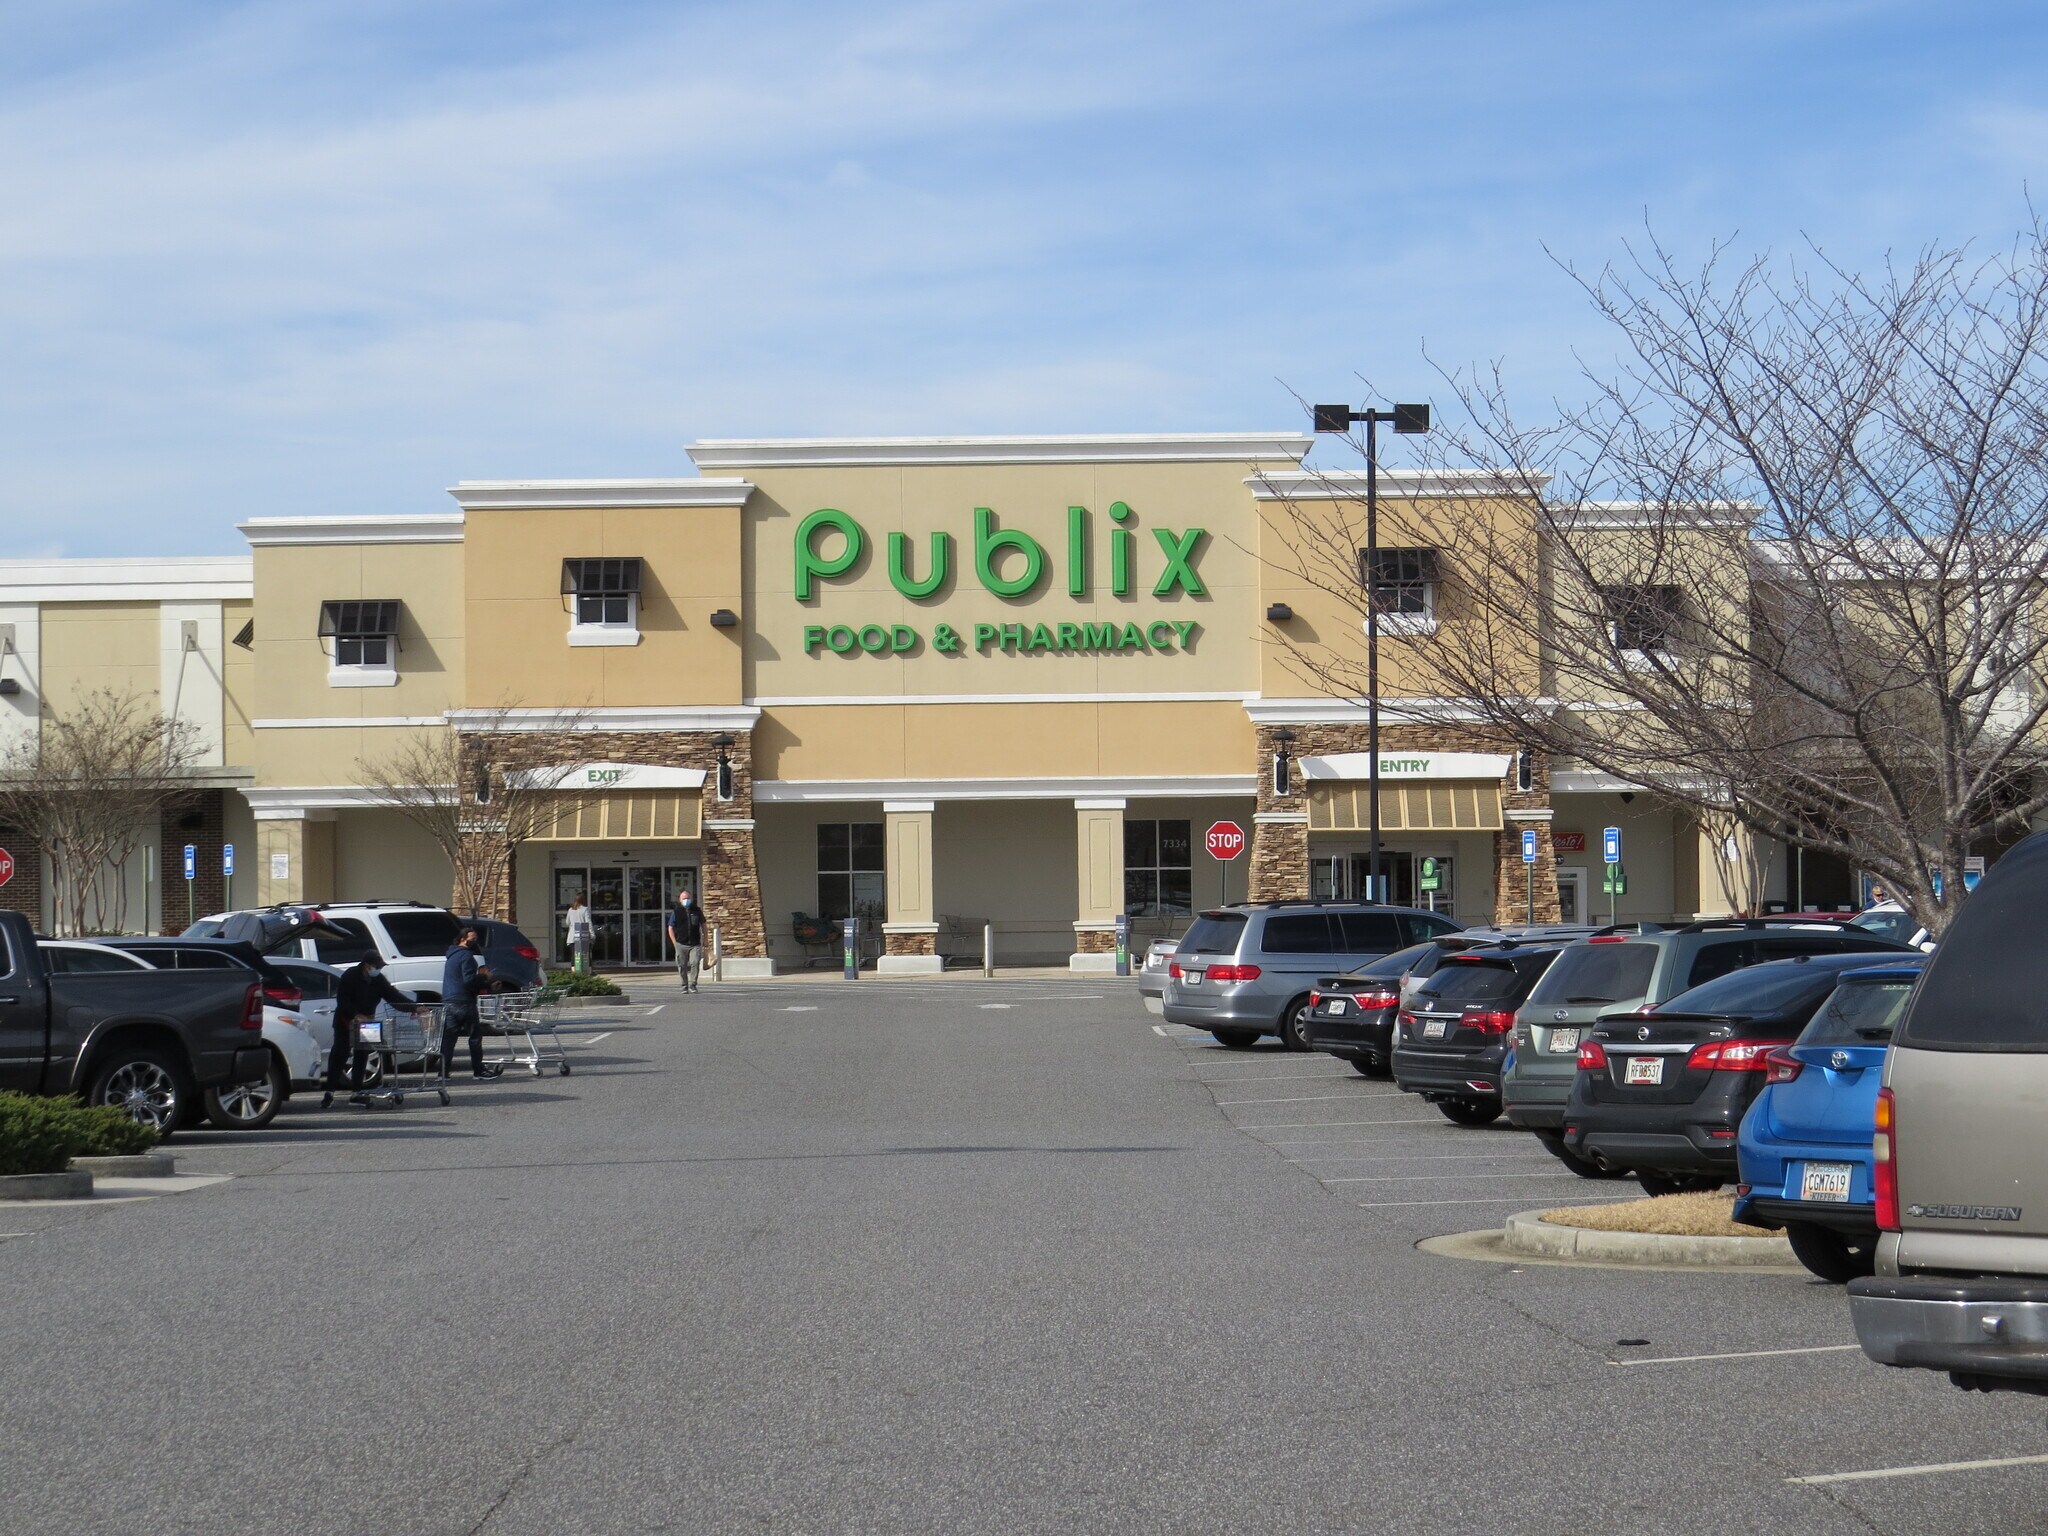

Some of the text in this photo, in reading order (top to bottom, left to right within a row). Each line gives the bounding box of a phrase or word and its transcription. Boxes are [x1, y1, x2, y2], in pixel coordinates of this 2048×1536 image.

[794, 501, 1206, 600] Publix
[804, 621, 1207, 652] FOOD & PHARMACY
[1380, 759, 1430, 772] ENTRY
[588, 769, 621, 782] EXIT
[1163, 839, 1187, 848] 7334
[1208, 833, 1241, 848] STOP
[1808, 1174, 1846, 1192] CGM7619
[1925, 1204, 2021, 1221] SUBURBAN
